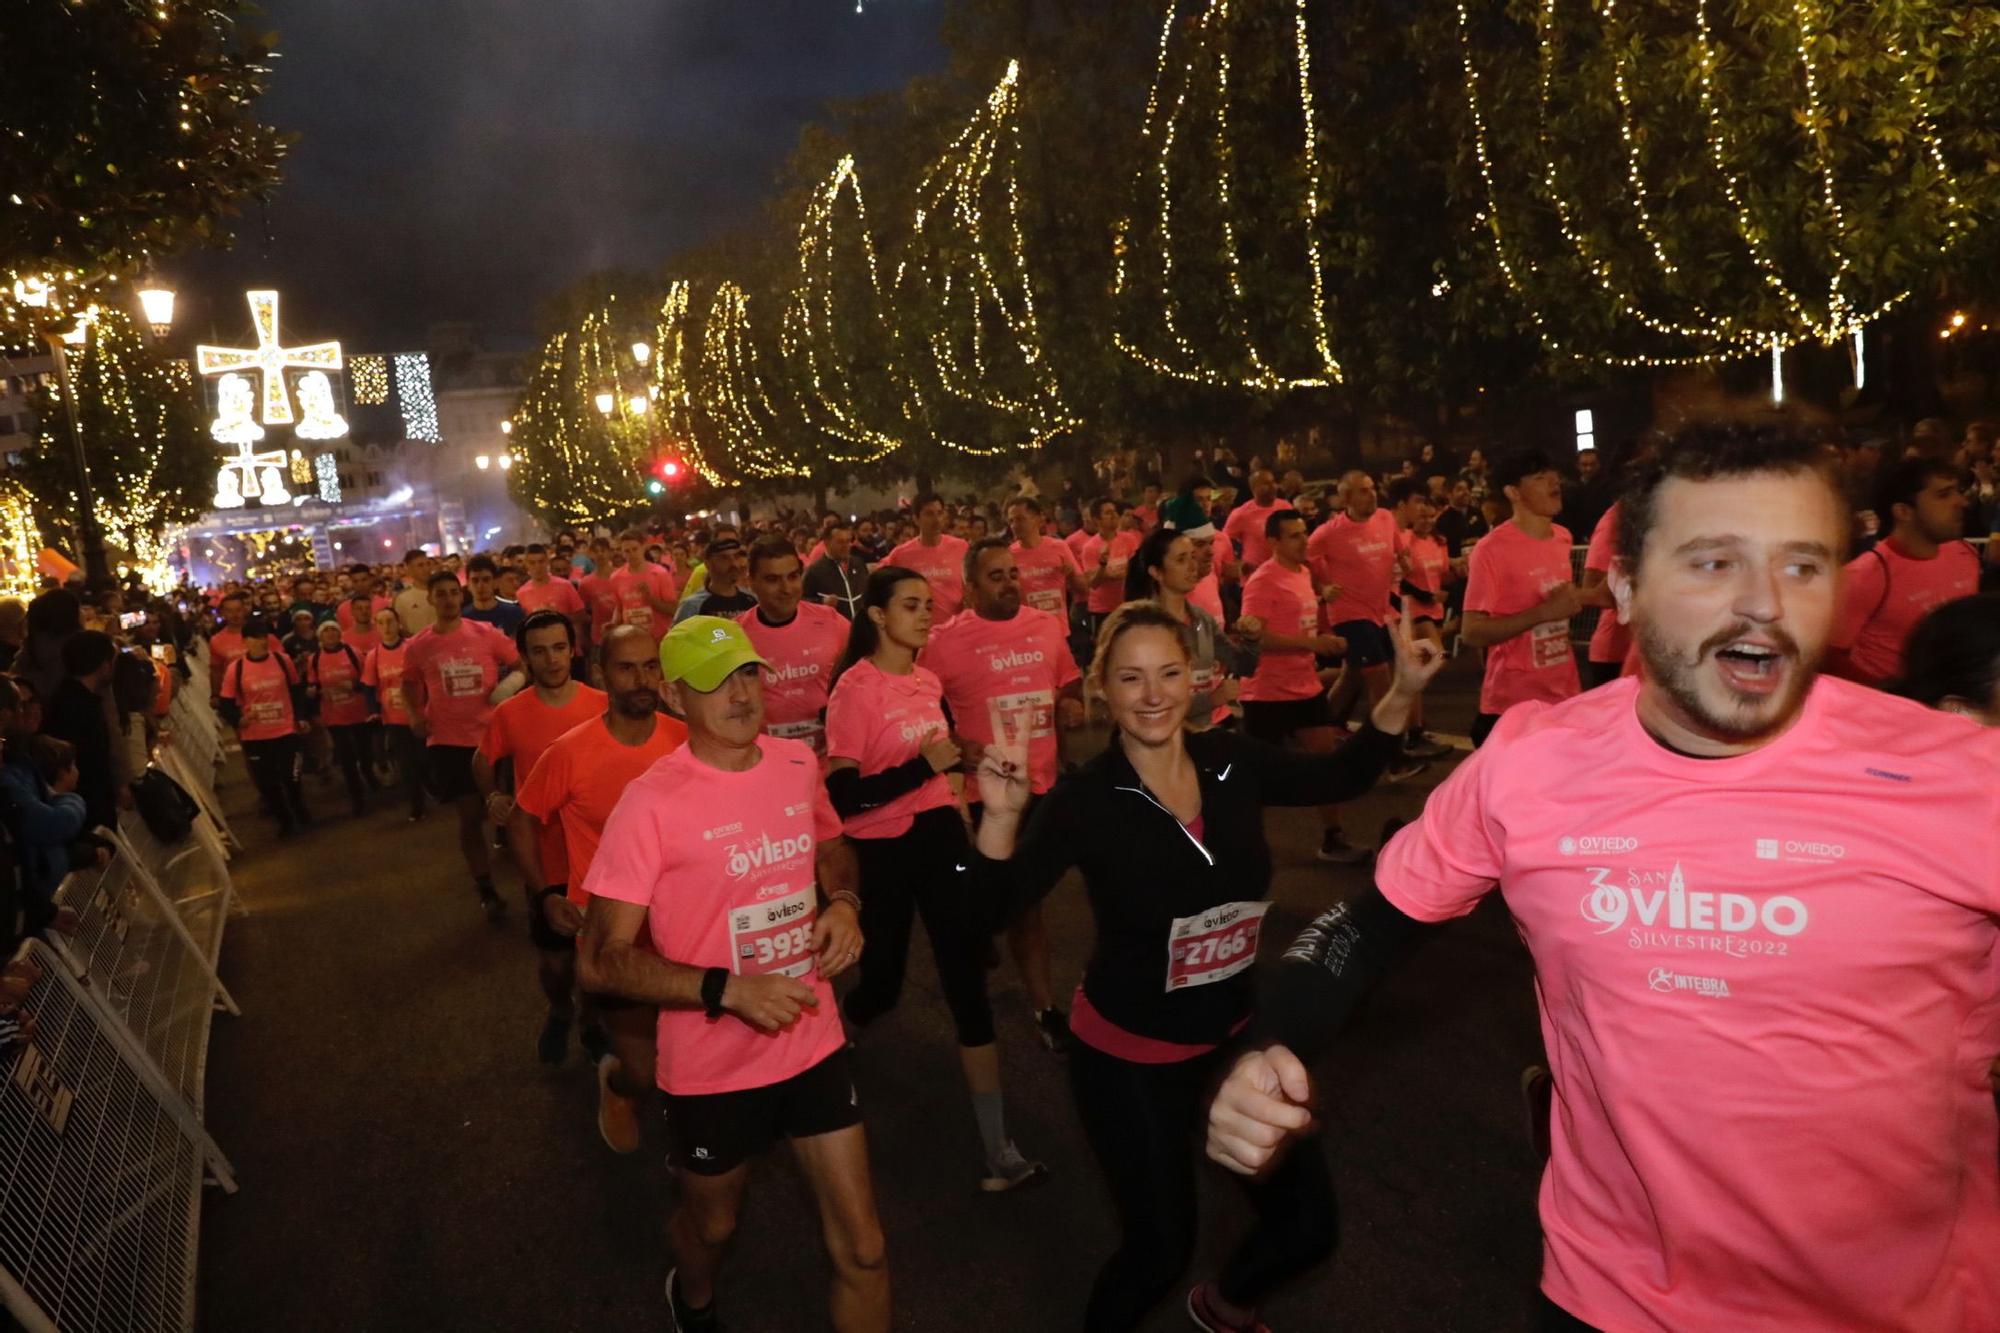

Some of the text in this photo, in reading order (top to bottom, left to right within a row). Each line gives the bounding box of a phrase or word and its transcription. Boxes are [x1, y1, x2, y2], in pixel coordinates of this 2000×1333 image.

[730, 830, 812, 875] OVIEDO
[1579, 836, 1638, 850] OVIEDO
[1785, 840, 1845, 858] OVIEDO
[1588, 861, 1809, 936] OVIEDO
[1184, 928, 1246, 965] 2766
